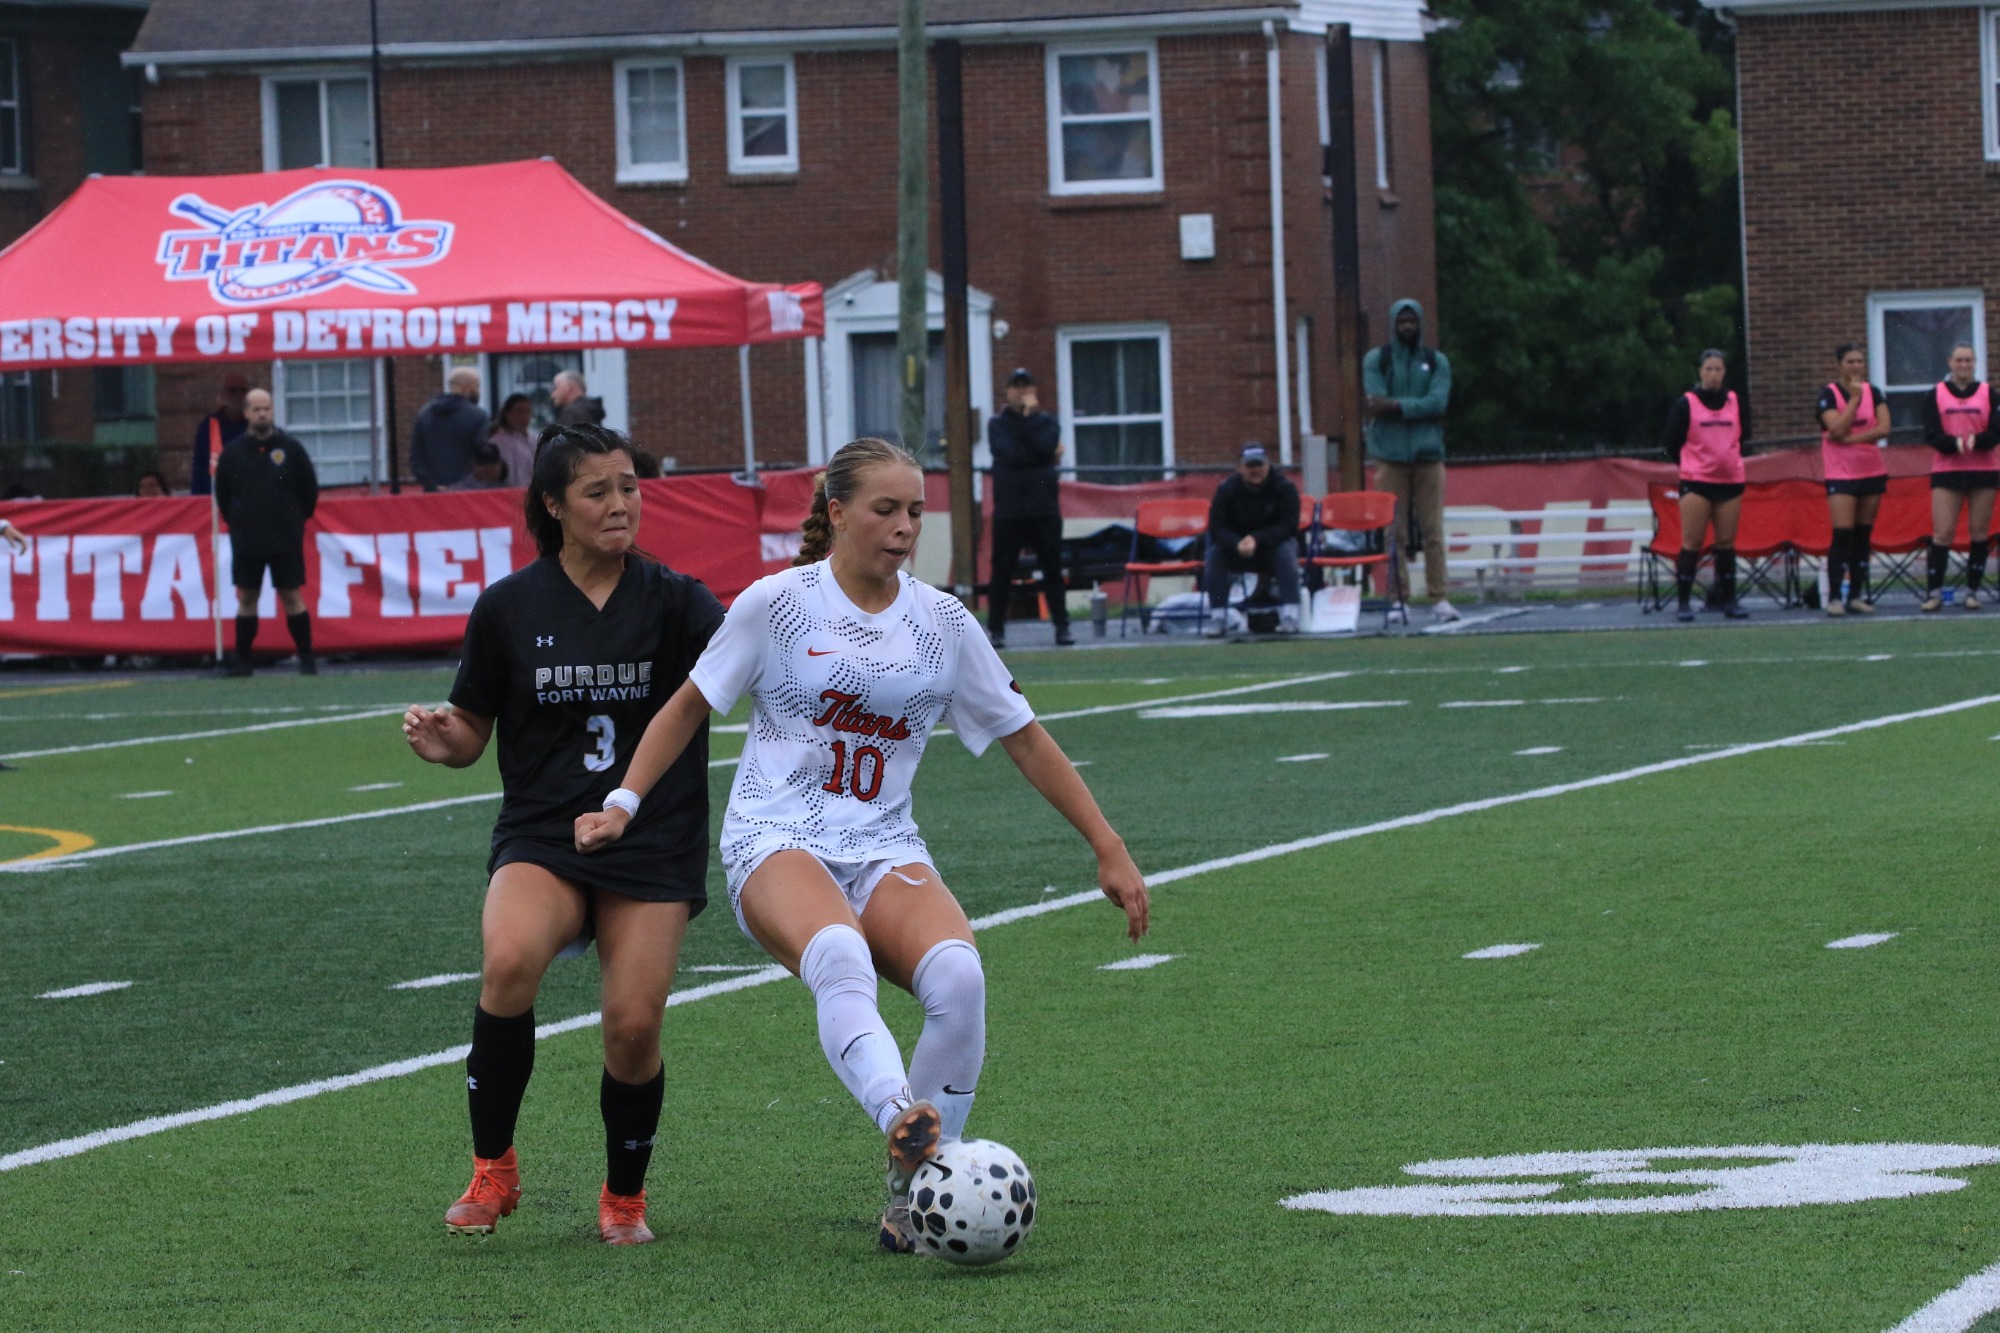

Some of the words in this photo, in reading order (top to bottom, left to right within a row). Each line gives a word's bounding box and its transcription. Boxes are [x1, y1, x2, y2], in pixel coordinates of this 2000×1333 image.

[167, 225, 445, 275] TITANS
[0, 316, 181, 362] ERSITY
[195, 311, 260, 355] OF
[272, 304, 492, 352] DETROIT
[506, 298, 679, 346] MERCY
[0, 533, 277, 620] ITA
[315, 527, 513, 618] FIE
[535, 661, 653, 690] PURDUE
[536, 688, 585, 705] FORT
[590, 684, 651, 701] WAYNE
[813, 688, 911, 740] Titans
[583, 714, 616, 772] 3
[822, 740, 884, 801] 10
